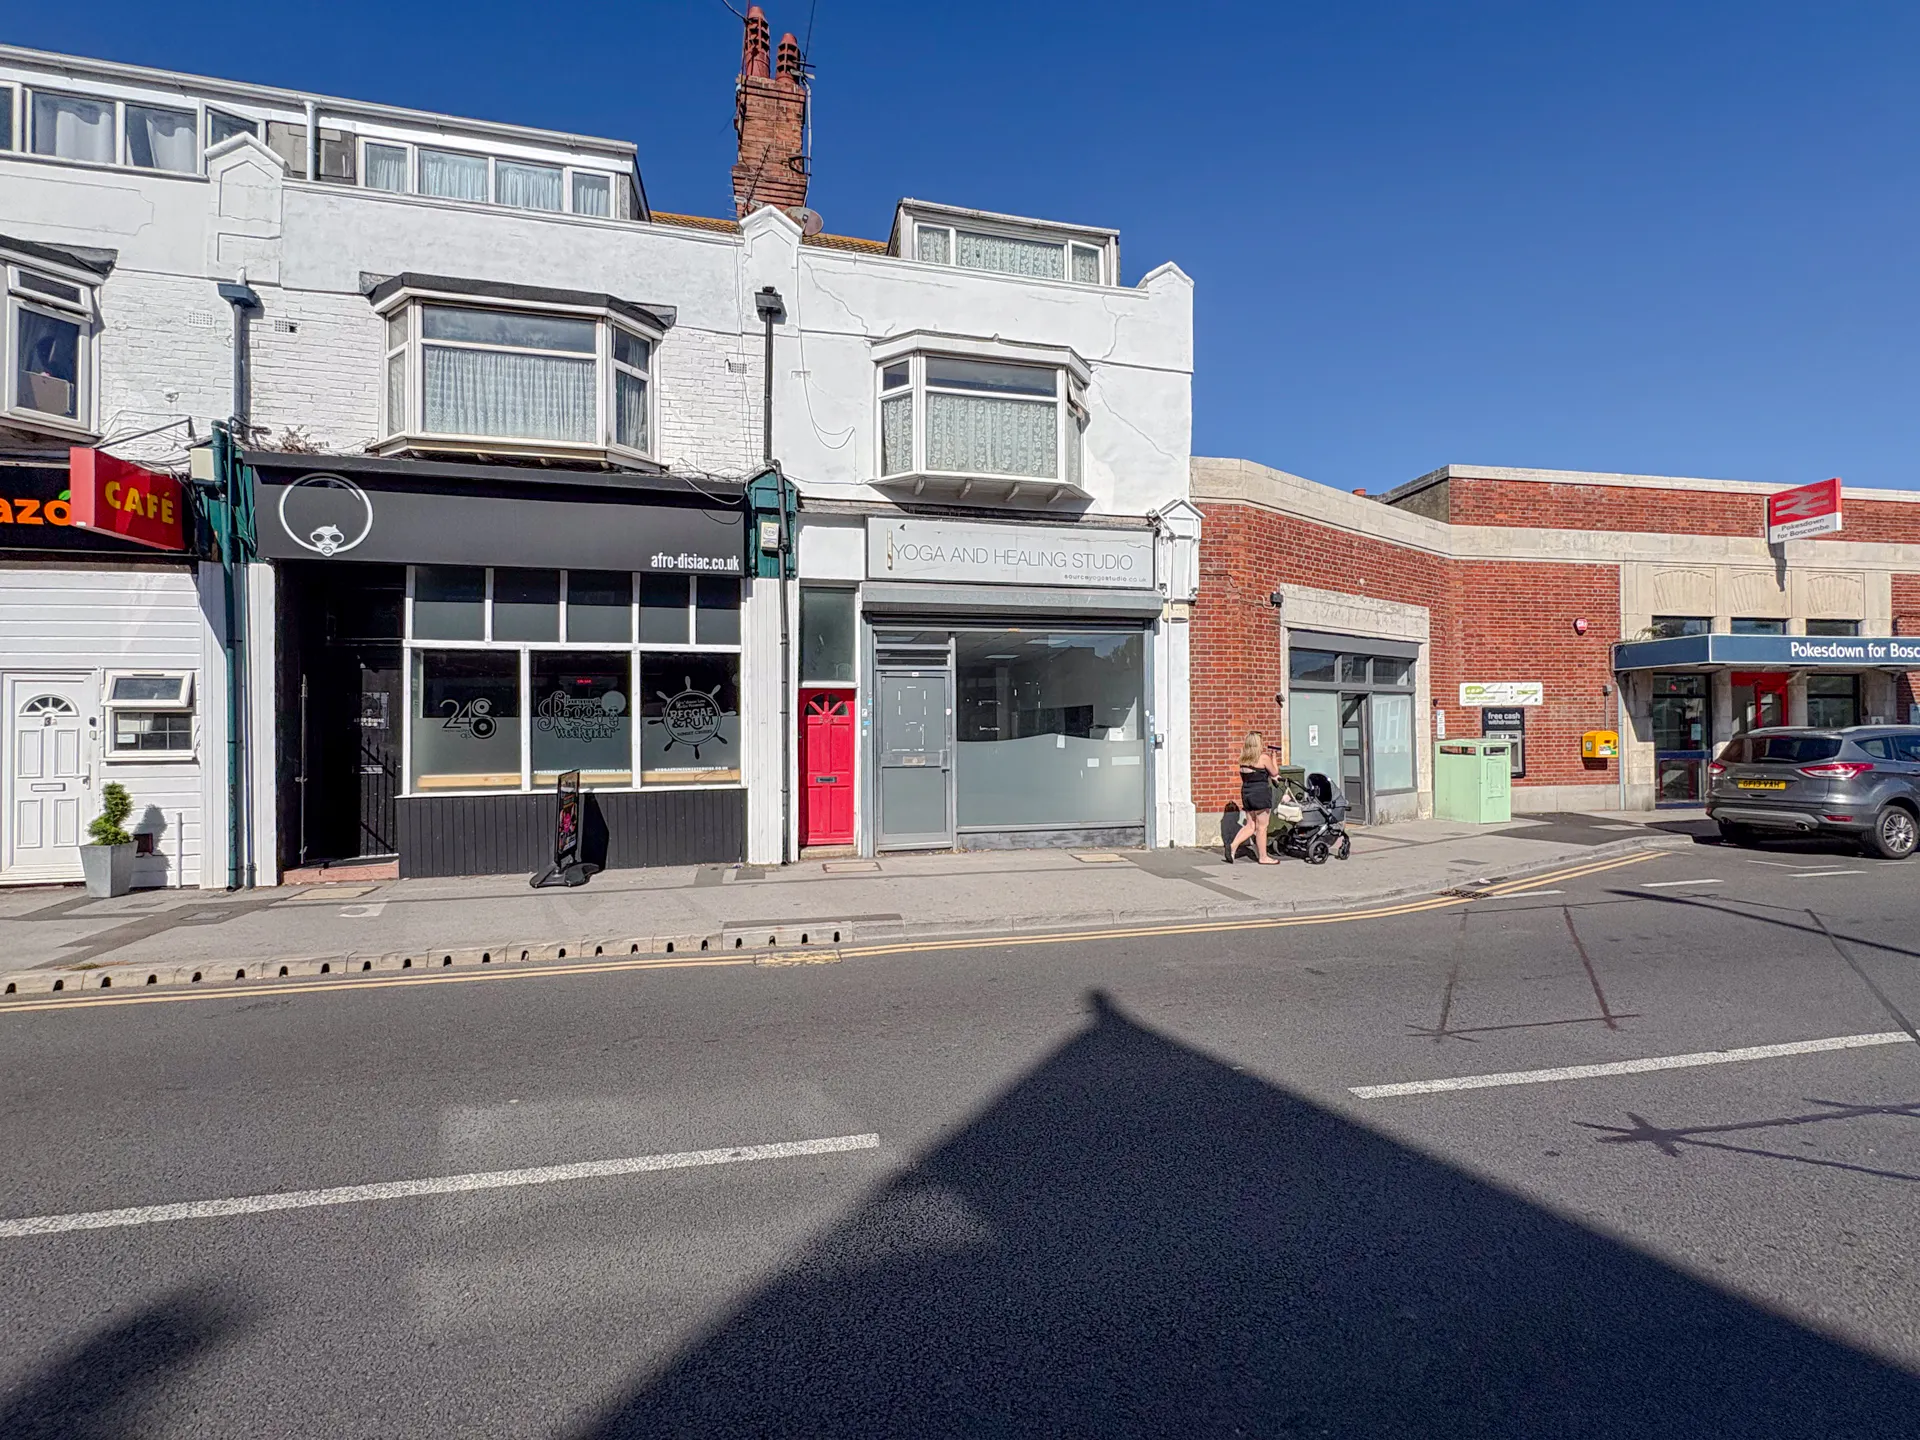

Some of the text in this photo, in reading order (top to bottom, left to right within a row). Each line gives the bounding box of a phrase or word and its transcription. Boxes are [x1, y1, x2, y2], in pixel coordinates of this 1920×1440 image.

[105, 481, 174, 525] CAFÉ
[1781, 518, 1825, 531] Pokesdown
[1789, 524, 1830, 537] Boscombe
[651, 552, 740, 571] afro-disiac.co.uk
[892, 543, 1133, 571] YOGA AND HEALING STUDIO
[1790, 641, 1864, 658] Pokesdown
[1867, 642, 1887, 658] for
[669, 707, 714, 721] REGGAE
[1488, 711, 1520, 720] free cash
